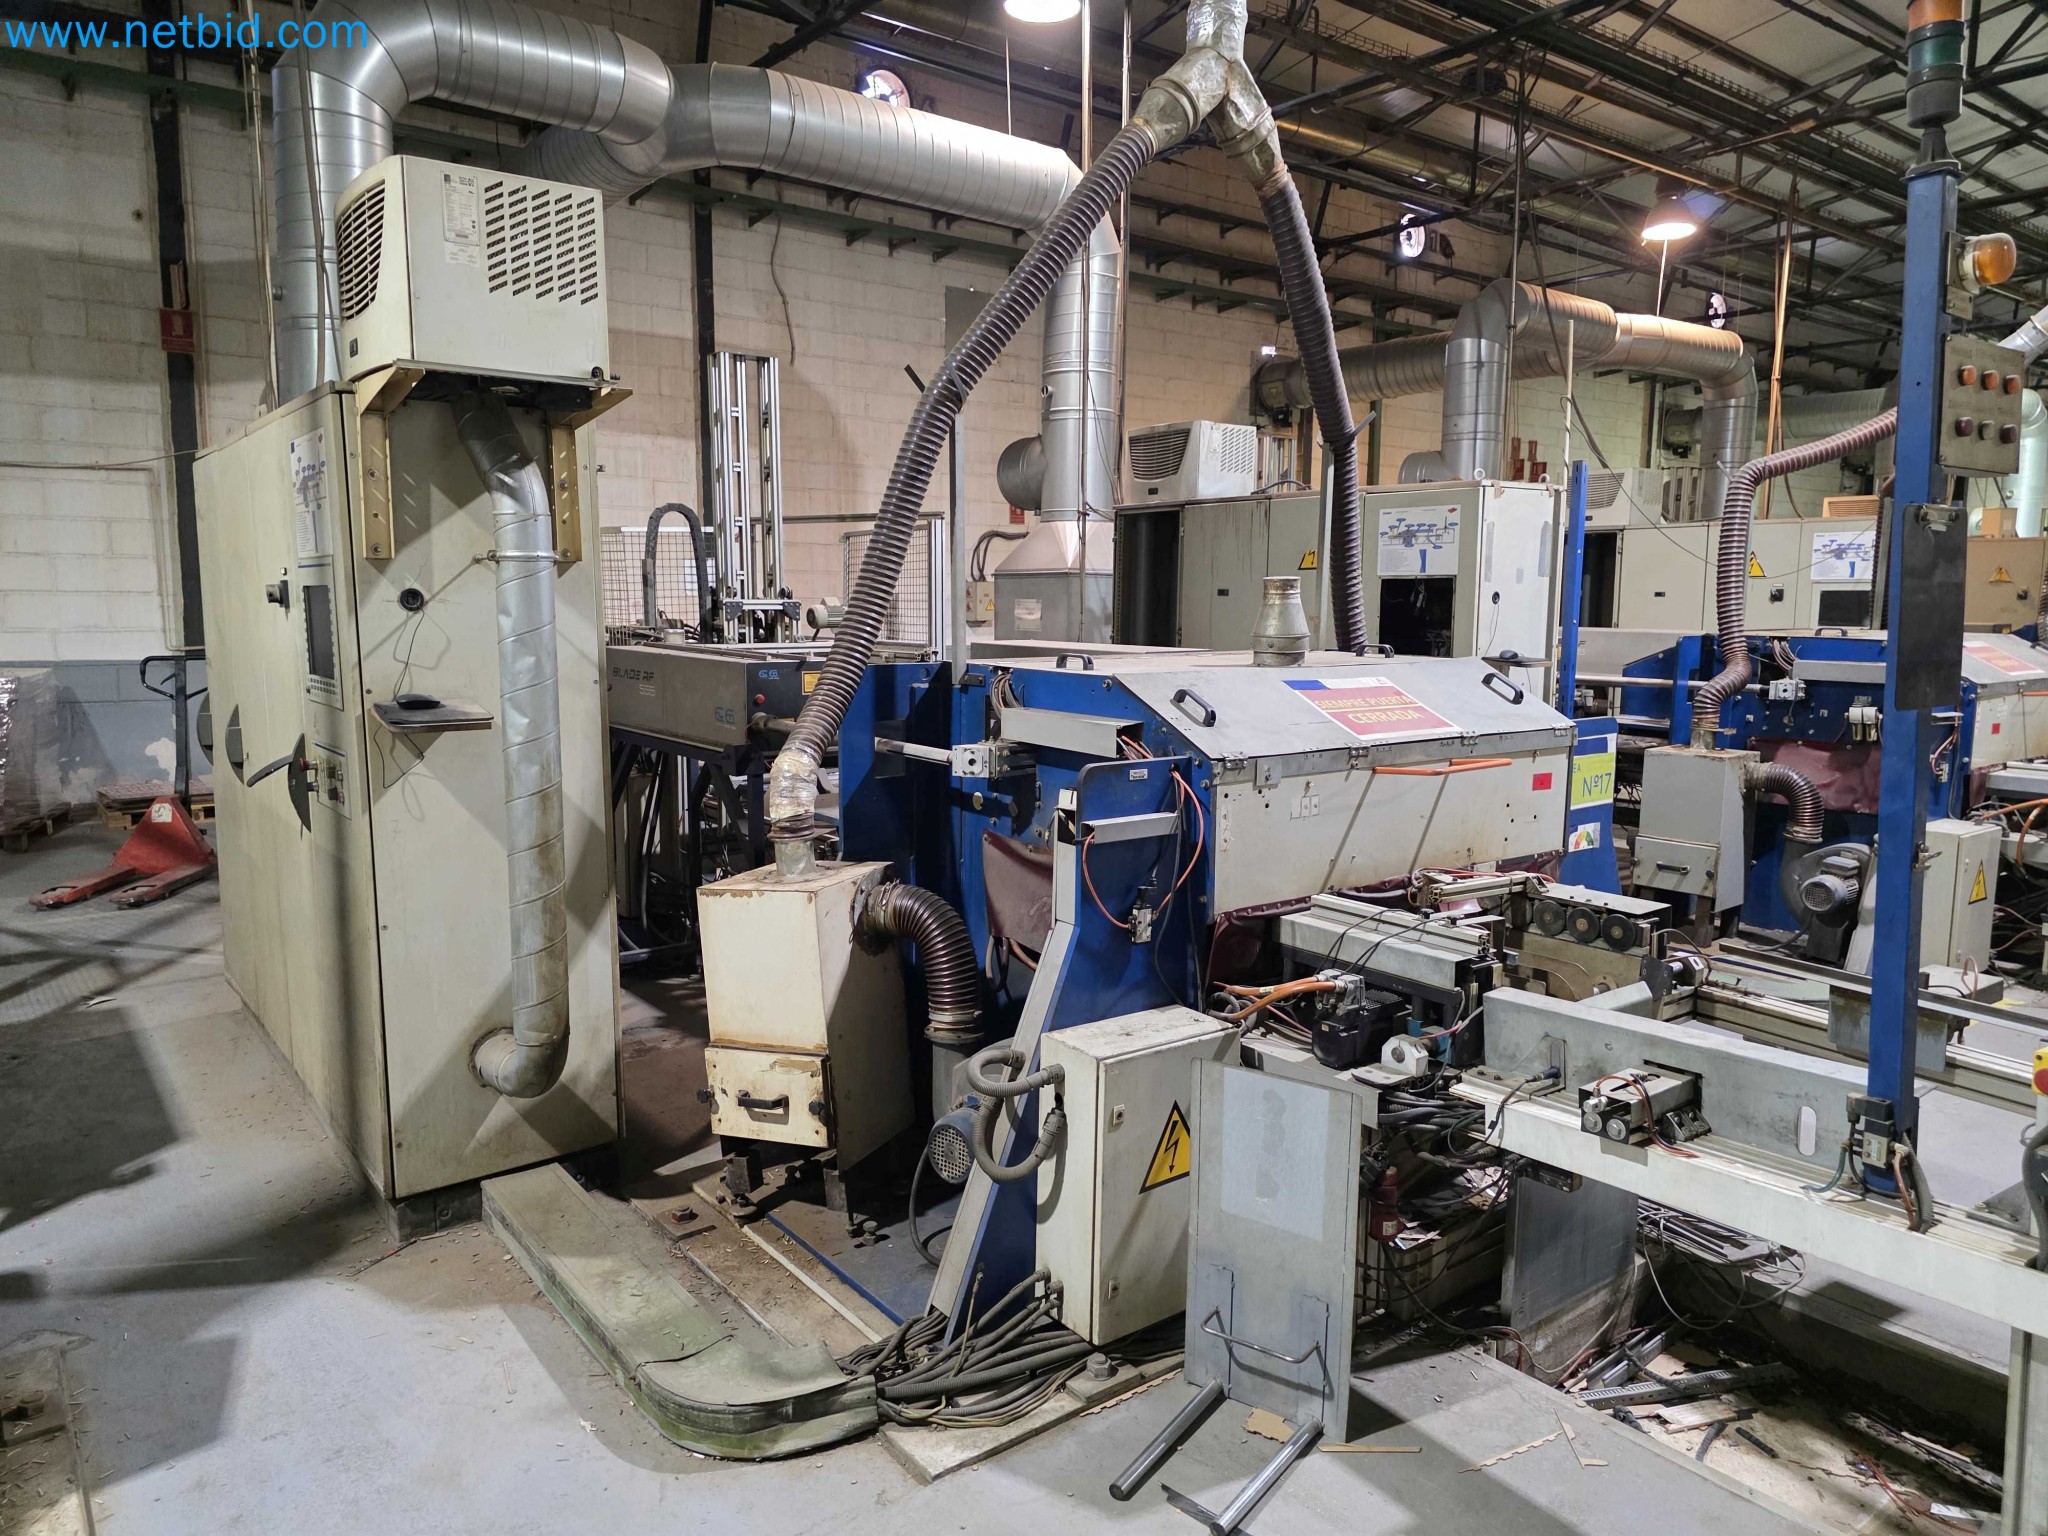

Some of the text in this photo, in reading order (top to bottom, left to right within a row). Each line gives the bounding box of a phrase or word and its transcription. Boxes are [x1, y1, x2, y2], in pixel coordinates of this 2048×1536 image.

[613, 667, 655, 681] BLADE RF
[1315, 696, 1414, 709] SIEMPRE PUERTA
[1348, 709, 1425, 724] CERRADA
